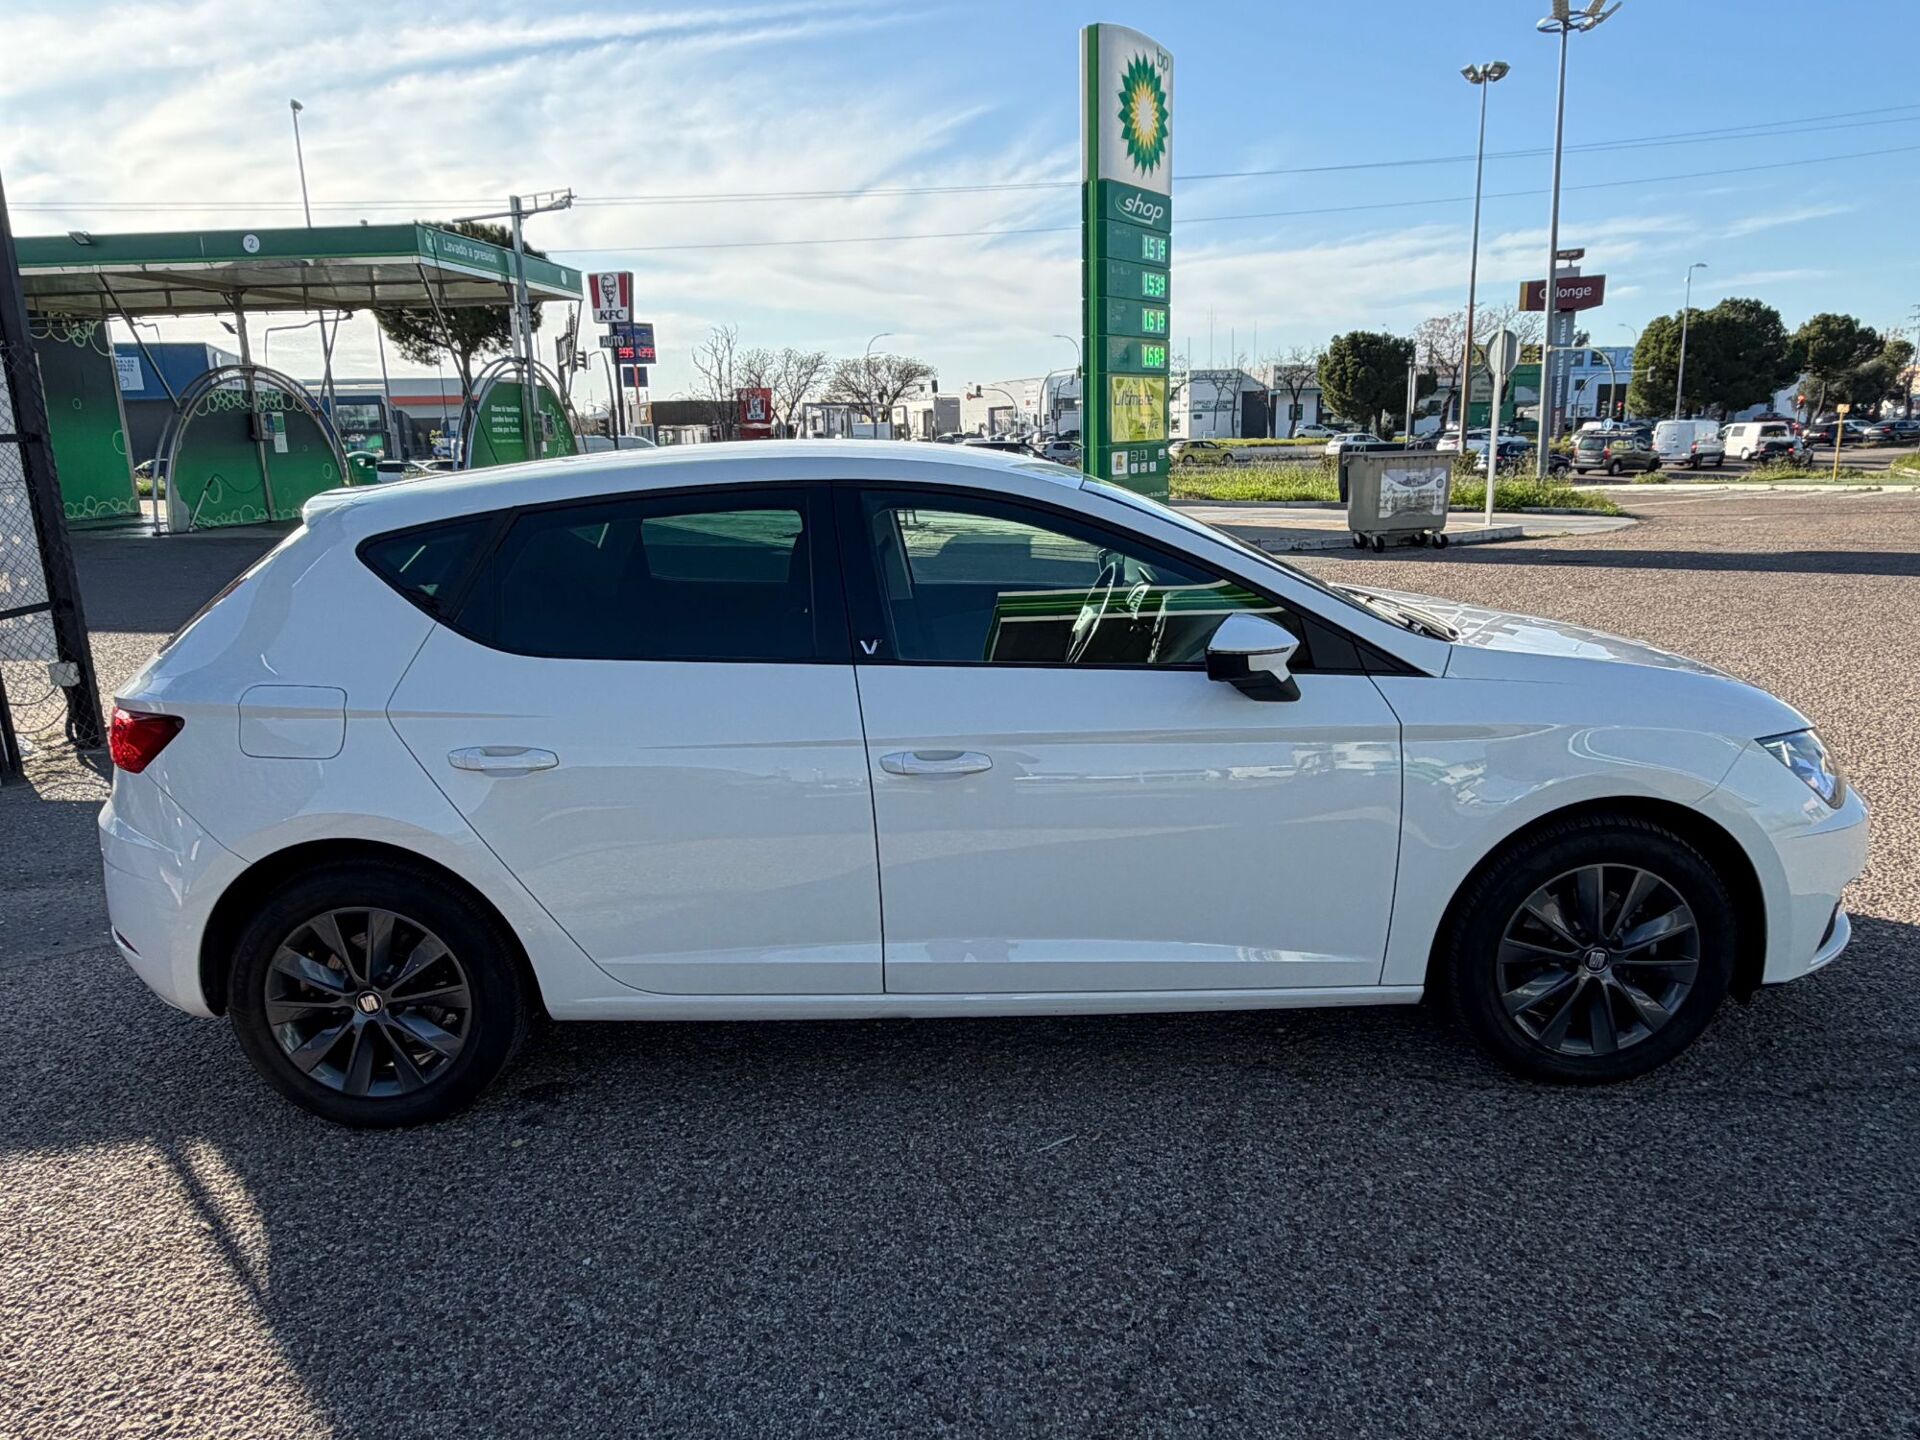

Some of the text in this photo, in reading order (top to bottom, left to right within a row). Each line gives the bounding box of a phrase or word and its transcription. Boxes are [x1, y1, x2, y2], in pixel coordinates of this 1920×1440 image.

[1124, 193, 1164, 225] shop
[247, 238, 255, 249] 2
[442, 239, 468, 256] Lavado
[1538, 286, 1592, 300] Clonge
[599, 309, 625, 321] KFC
[601, 335, 625, 348] AUTO
